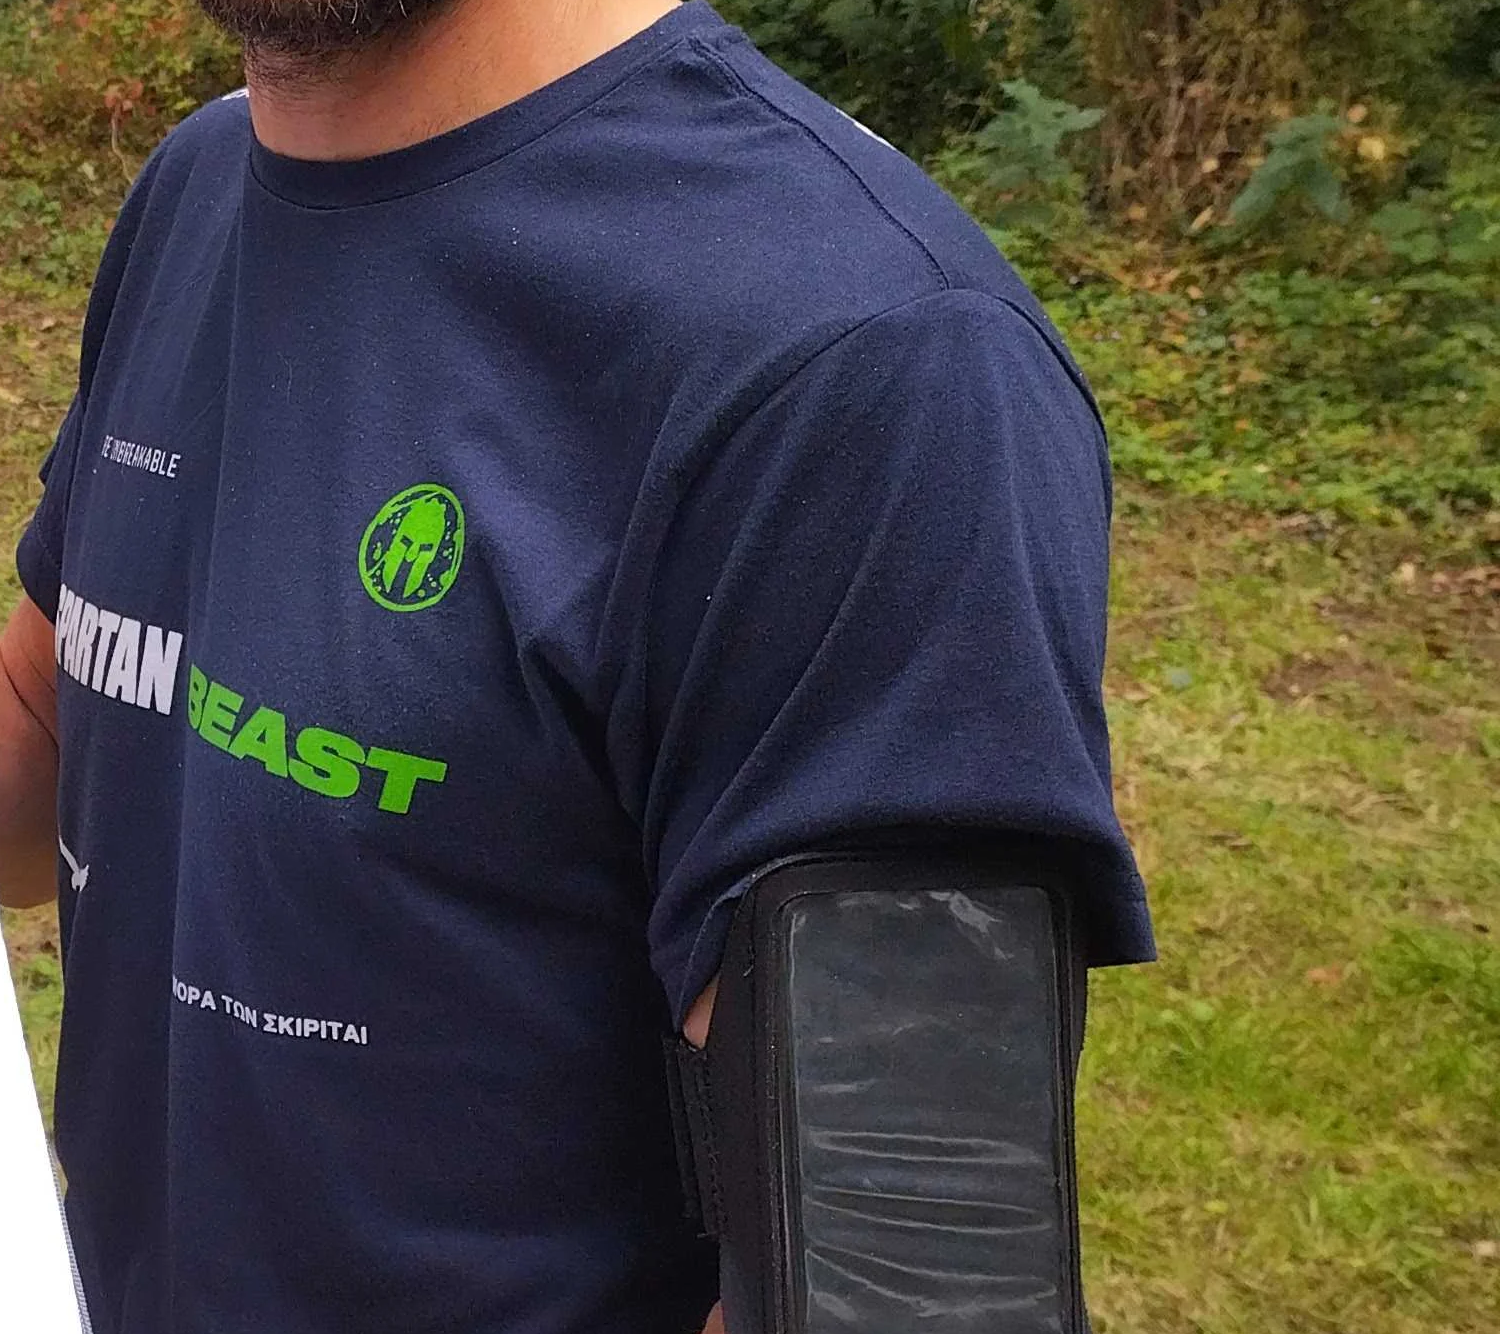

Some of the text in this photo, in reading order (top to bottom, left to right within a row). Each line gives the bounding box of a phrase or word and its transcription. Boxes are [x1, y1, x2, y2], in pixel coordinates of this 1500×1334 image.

[187, 663, 448, 815] BEAST
[221, 994, 258, 1028] ΤΩΝ
[262, 1012, 368, 1045] ΣΚΙΡΙΤΑΙ
